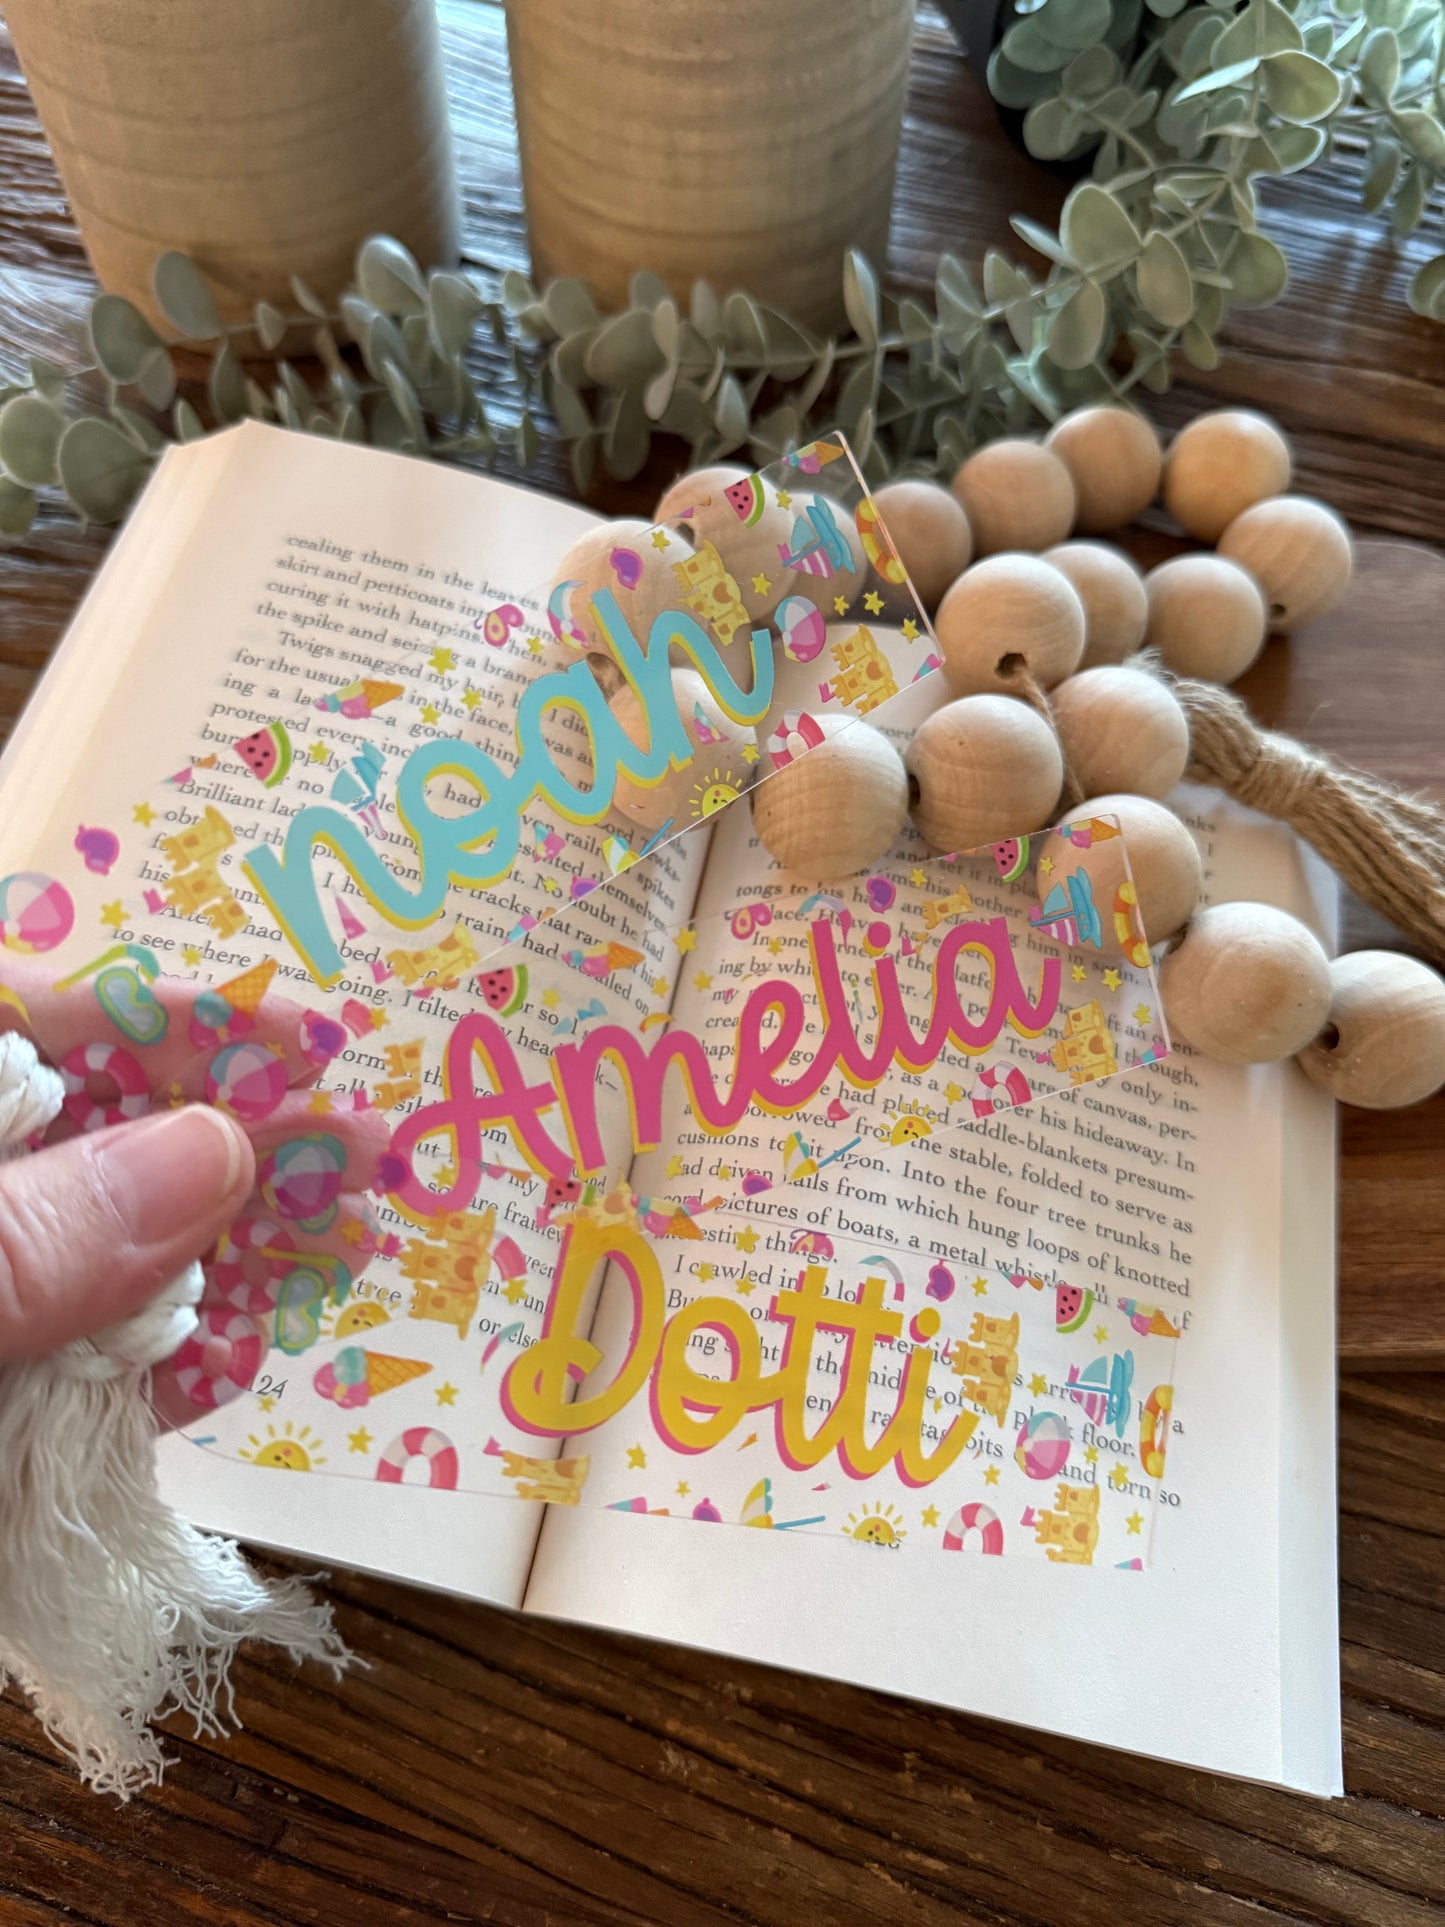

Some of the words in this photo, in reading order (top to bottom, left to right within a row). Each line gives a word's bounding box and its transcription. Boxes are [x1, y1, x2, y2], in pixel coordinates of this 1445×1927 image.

[275, 555, 319, 576] skirt
[324, 571, 362, 585] and
[363, 578, 455, 611] petticoats
[286, 537, 354, 562] cealing
[362, 550, 409, 572] them
[417, 563, 435, 580] in
[444, 571, 474, 591] the
[266, 581, 330, 607] curing
[336, 593, 350, 608] it
[358, 601, 401, 621] with
[257, 601, 288, 619] the
[290, 613, 345, 632] spike
[349, 626, 388, 643] and
[466, 657, 476, 668] a
[280, 630, 335, 658] Twigs
[339, 650, 424, 679] snagged
[427, 672, 460, 691] my
[223, 672, 257, 697] ing
[268, 688, 280, 699] a
[233, 647, 264, 667] for
[269, 657, 301, 675] the
[410, 689, 428, 706] in
[434, 698, 465, 719] the
[469, 707, 514, 735] face,
[178, 778, 266, 811] Brilliant
[296, 779, 325, 795] no
[470, 886, 532, 917] tracks
[735, 881, 782, 900] tongs
[790, 883, 808, 895] to
[140, 934, 175, 951] see
[522, 932, 560, 960] had
[718, 959, 744, 977] ing
[750, 956, 771, 977] by
[390, 914, 1062, 1224] Amelia
[1121, 1079, 1162, 1105] only
[1173, 1091, 1199, 1113] in-
[1040, 1106, 1067, 1131] his
[1073, 1116, 1169, 1166] hideaway.
[1175, 1150, 1195, 1172] In
[1083, 1096, 1153, 1130] canvas,
[1158, 1121, 1199, 1141] per-
[838, 1080, 876, 1105] had
[1114, 1166, 1195, 1201] presum-
[948, 1146, 1013, 1177] stable,
[1021, 1161, 1083, 1198] folded
[1090, 1187, 1109, 1207] to
[1114, 1199, 1167, 1226] serve
[1172, 1217, 1194, 1234] as
[901, 1159, 945, 1187] Into
[954, 1174, 987, 1200] the
[995, 1186, 1039, 1215] four
[1047, 1206, 1087, 1231] tree
[1095, 1222, 1160, 1256] trunks
[1169, 1240, 1192, 1265] he
[806, 1207, 832, 1225] of
[836, 1208, 900, 1244] boats,
[908, 1235, 921, 1249] a
[928, 1240, 987, 1268] metal
[837, 1176, 888, 1206] from
[895, 1194, 959, 1226] which
[967, 1209, 1020, 1248] hung
[1026, 1228, 1081, 1263] loops
[1087, 1251, 1110, 1271] of
[1114, 1255, 1191, 1298] knotted
[674, 1254, 686, 1273] I
[500, 1220, 981, 1489] Dotti
[1081, 1422, 1136, 1457] floor.
[1172, 1419, 1184, 1434] a
[1159, 1487, 1181, 1507] so
